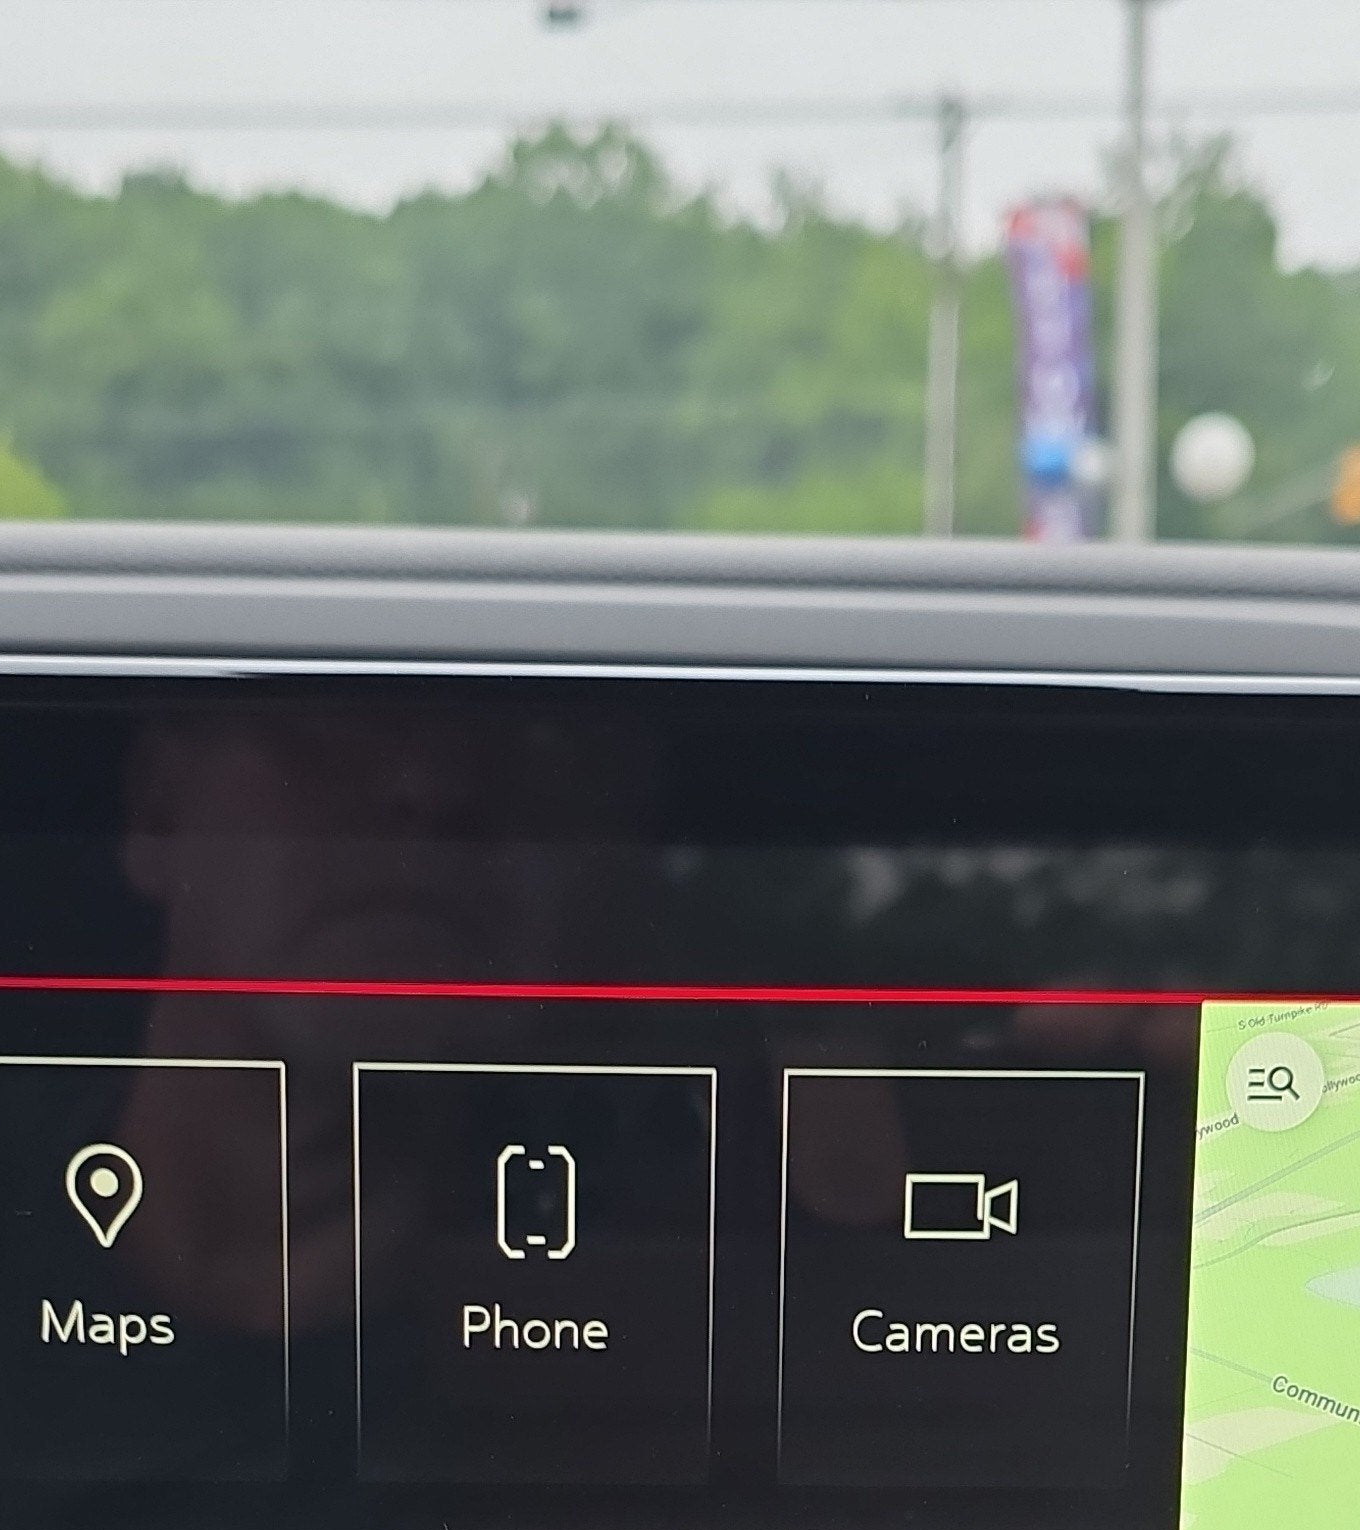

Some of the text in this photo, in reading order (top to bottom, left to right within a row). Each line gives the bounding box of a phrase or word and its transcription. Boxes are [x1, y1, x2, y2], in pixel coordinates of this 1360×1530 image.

[1196, 1112, 1239, 1140] ywood
[40, 1299, 176, 1356] Maps
[462, 1304, 609, 1352] Phone
[852, 1310, 1061, 1355] Cameras
